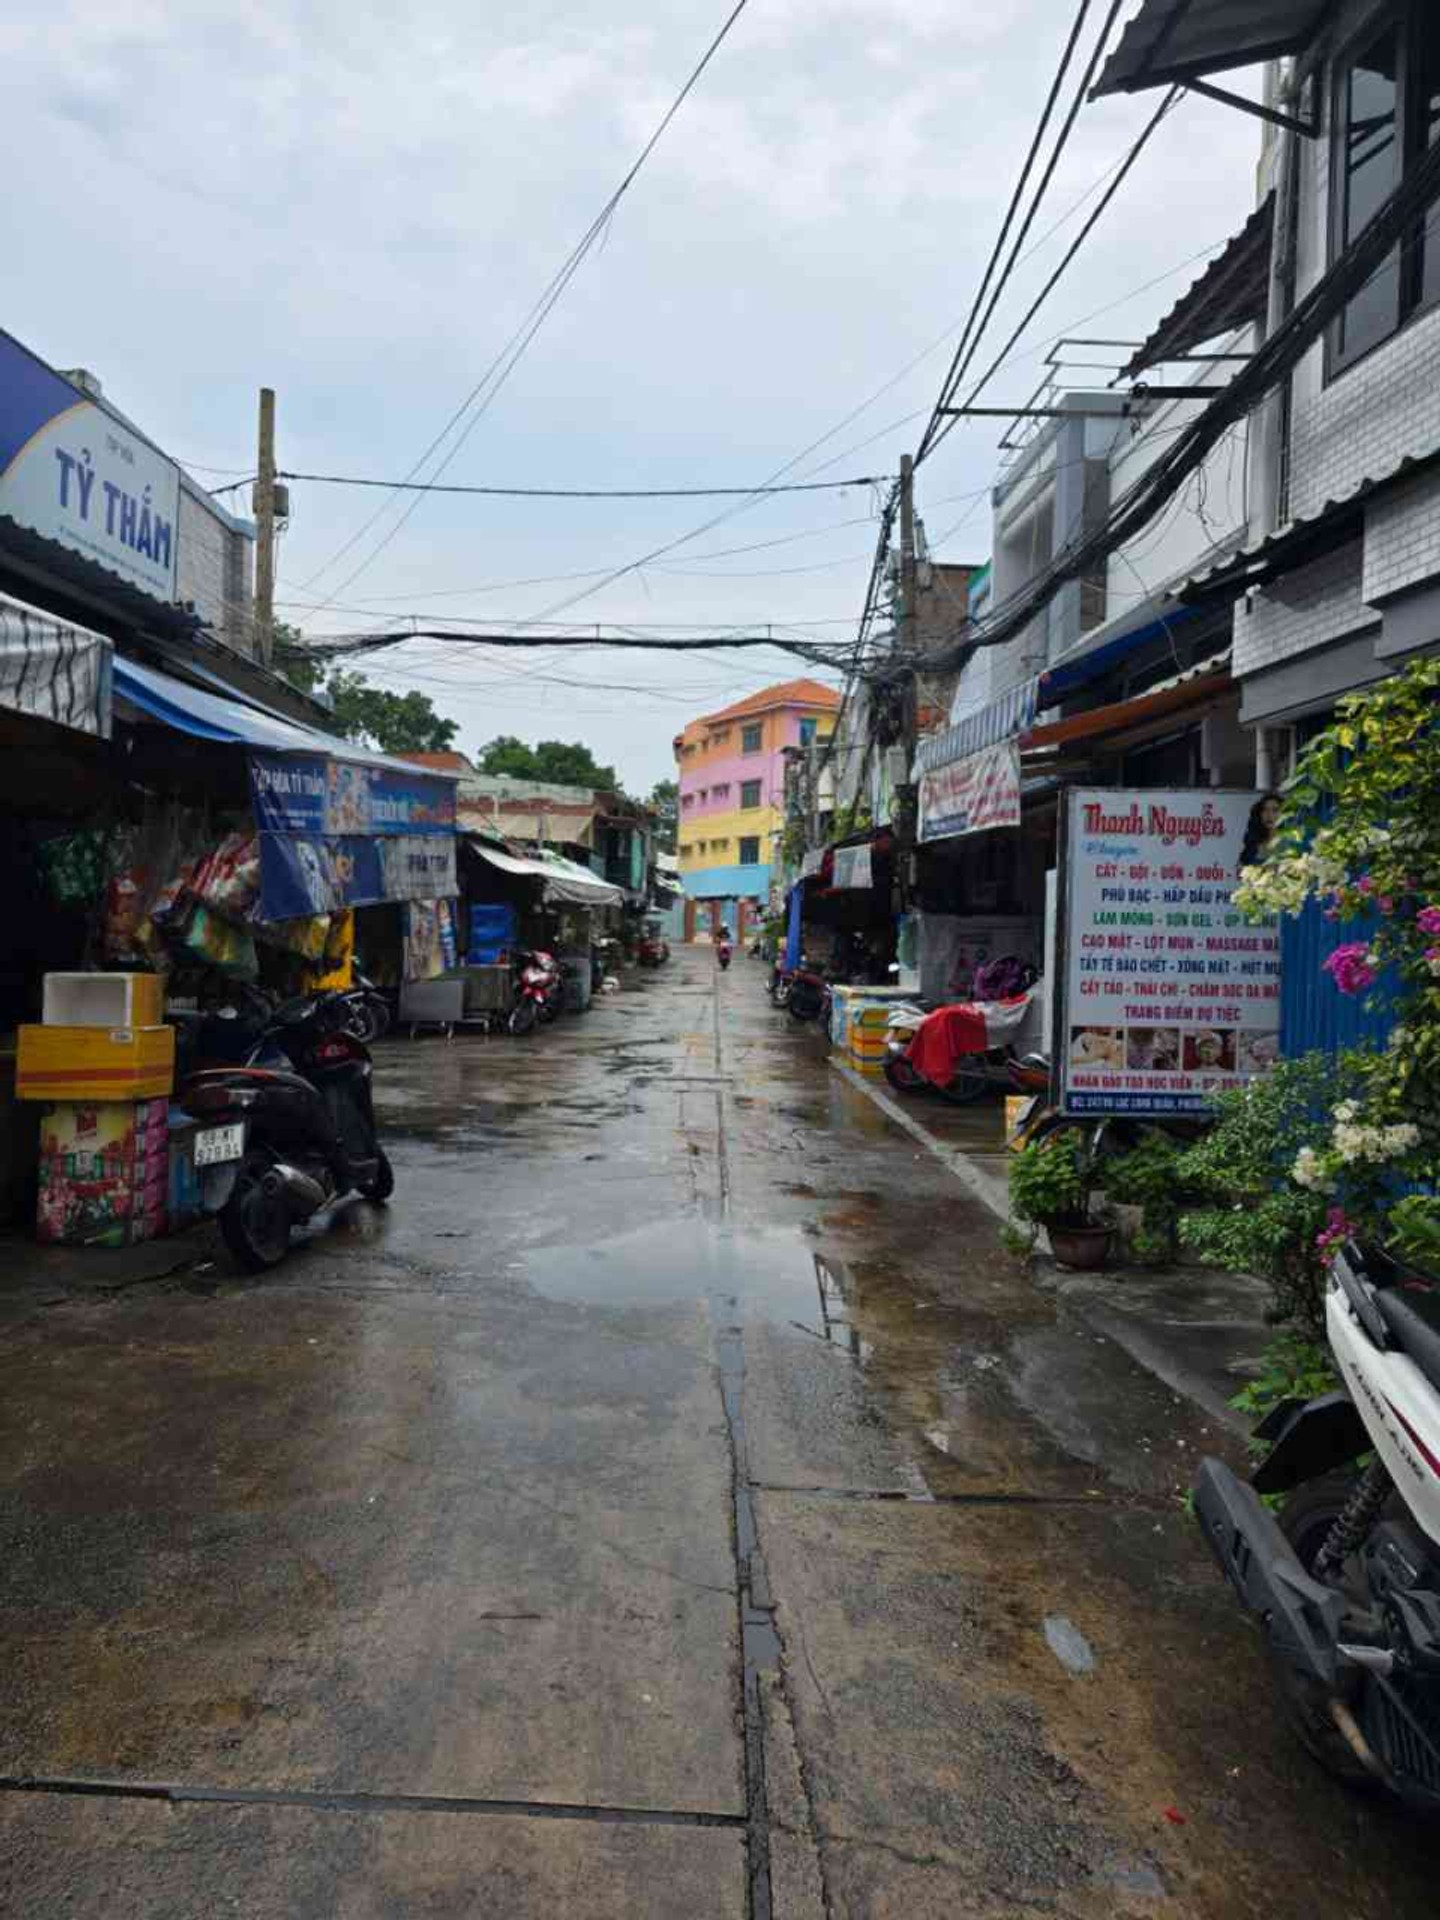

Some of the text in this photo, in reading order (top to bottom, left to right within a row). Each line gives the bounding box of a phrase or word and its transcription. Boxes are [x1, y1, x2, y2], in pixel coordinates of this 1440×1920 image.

[56, 447, 95, 521] TỶ
[1083, 803, 1225, 846] Thanh Nguyễn
